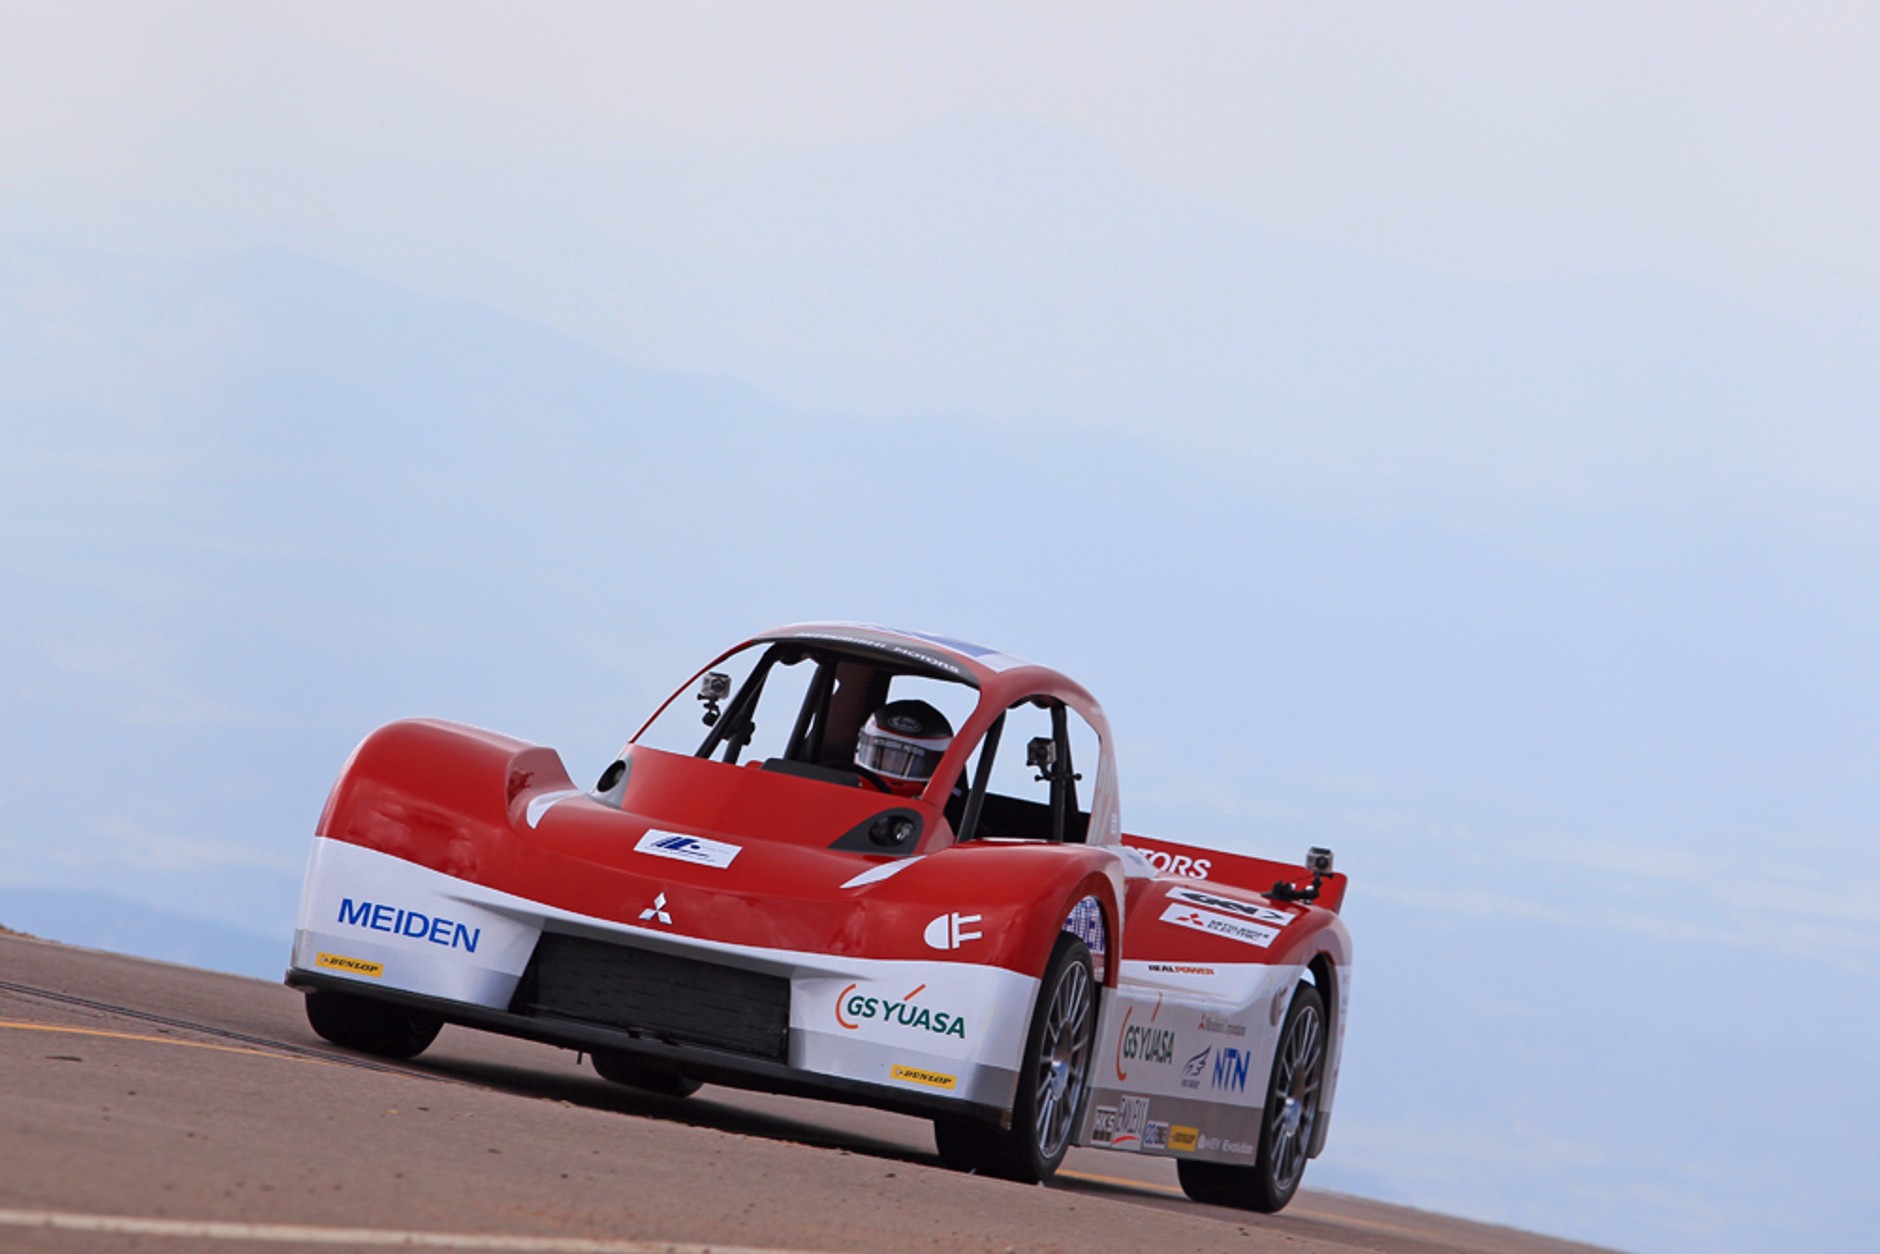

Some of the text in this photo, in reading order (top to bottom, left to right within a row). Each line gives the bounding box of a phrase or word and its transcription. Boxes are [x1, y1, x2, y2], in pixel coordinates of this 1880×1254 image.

[1124, 846, 1212, 880] TORS
[337, 898, 481, 953] MEIDEN
[329, 957, 378, 972] DUNLOP
[847, 995, 966, 1039] GS YUASA
[1123, 1025, 1140, 1060] GS
[1138, 1026, 1176, 1065] YUASA
[904, 1070, 952, 1085] DUNLOP
[1211, 1047, 1252, 1094] NTN
